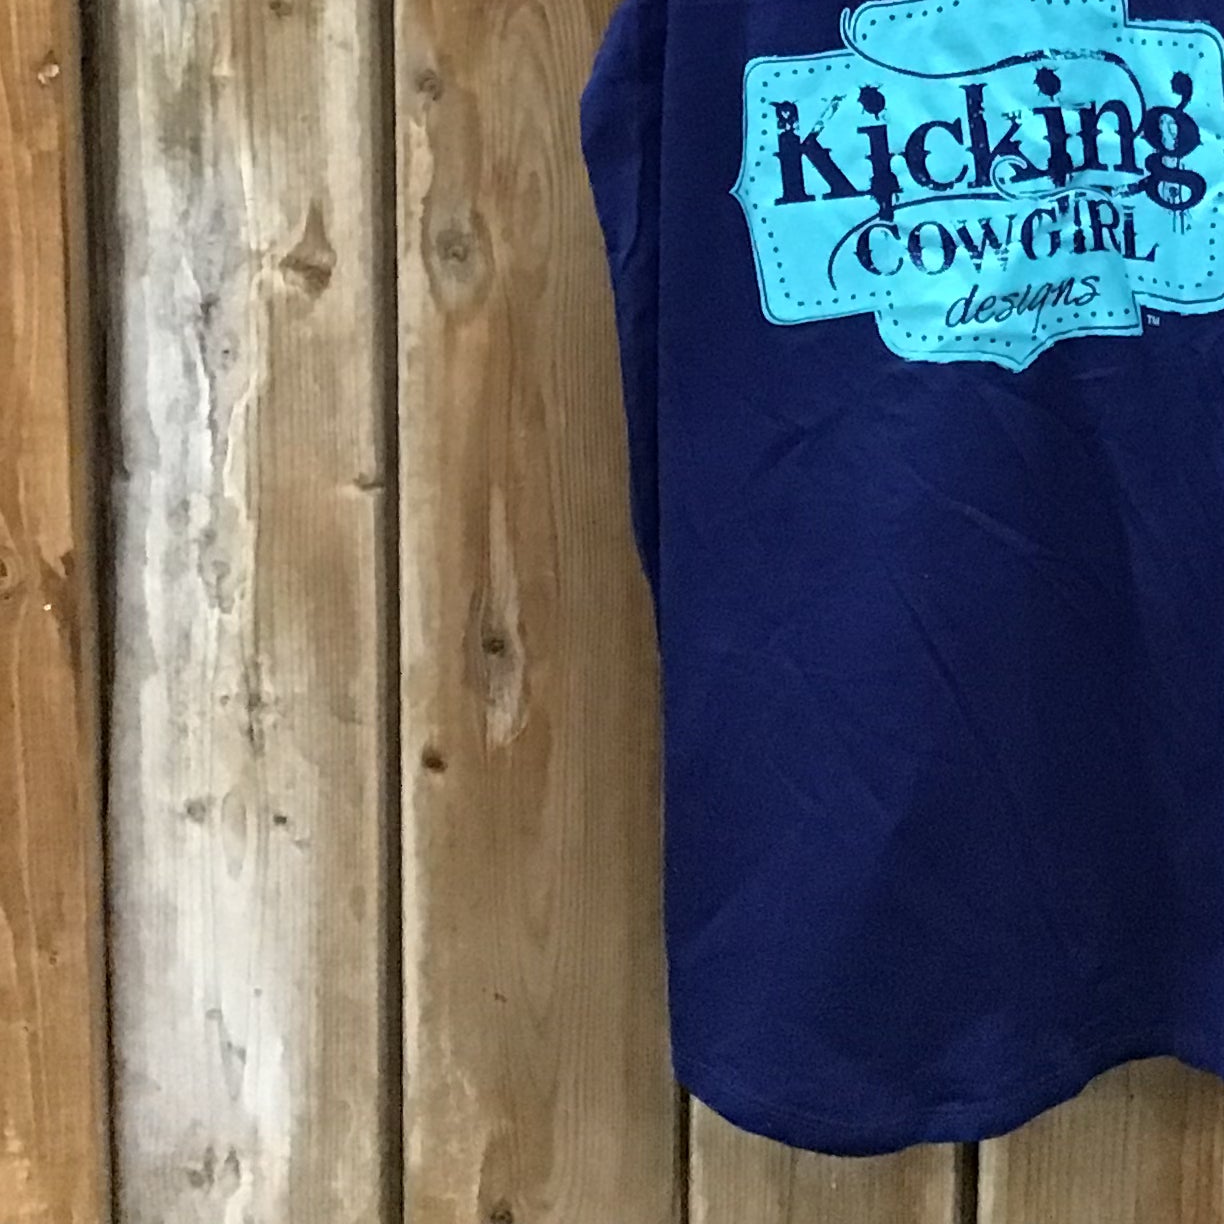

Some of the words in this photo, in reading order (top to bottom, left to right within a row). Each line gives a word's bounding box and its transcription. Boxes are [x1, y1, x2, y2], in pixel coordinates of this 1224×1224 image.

[768, 67, 1207, 213] Kicking
[854, 196, 1160, 277] COWGIRL
[945, 276, 1101, 333] designs
